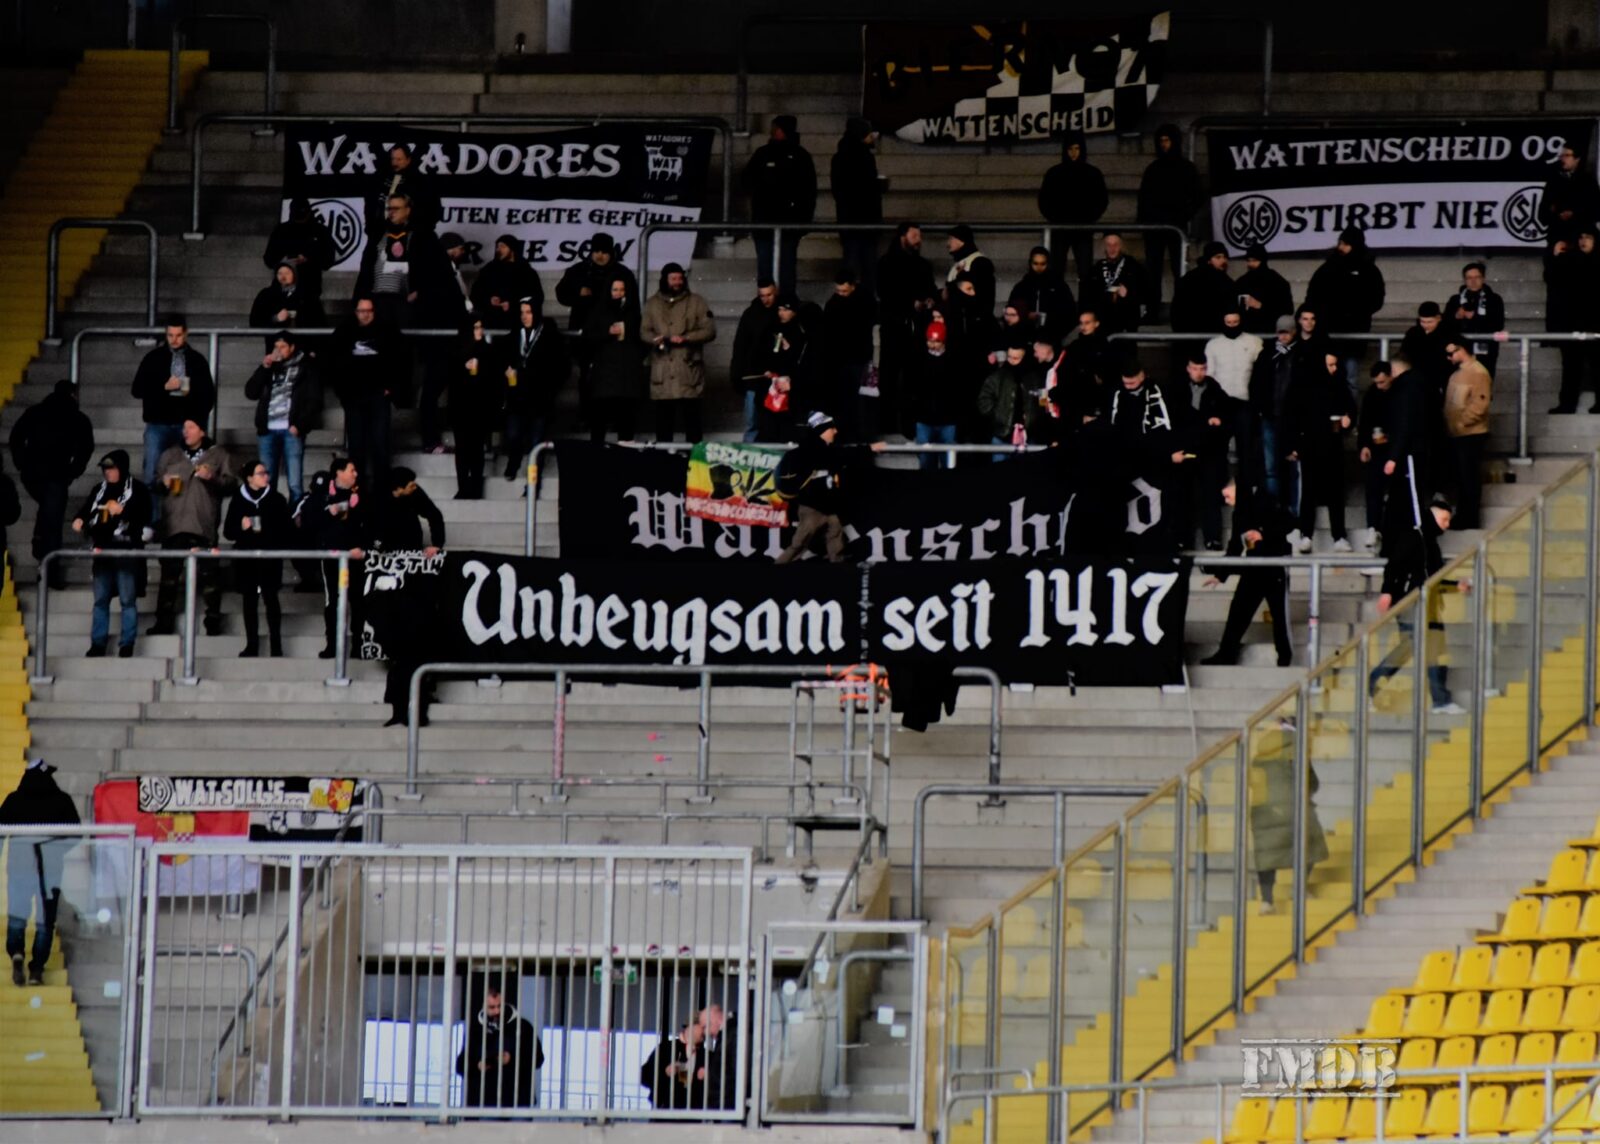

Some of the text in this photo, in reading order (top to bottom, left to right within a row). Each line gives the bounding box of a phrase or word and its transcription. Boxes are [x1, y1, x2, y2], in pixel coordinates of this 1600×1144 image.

[922, 104, 1115, 141] WATTENSCHEID
[296, 133, 622, 180] WAADORES
[652, 157, 677, 170] WAT
[1228, 135, 1564, 171] WATTENSCHEID 09
[507, 208, 581, 227] ECHTE
[1283, 200, 1498, 233] STIRBT NIE
[461, 560, 846, 665] Unbeugsam
[881, 578, 997, 653] seit
[1019, 566, 1180, 649] 1417
[173, 778, 219, 807] WAT
